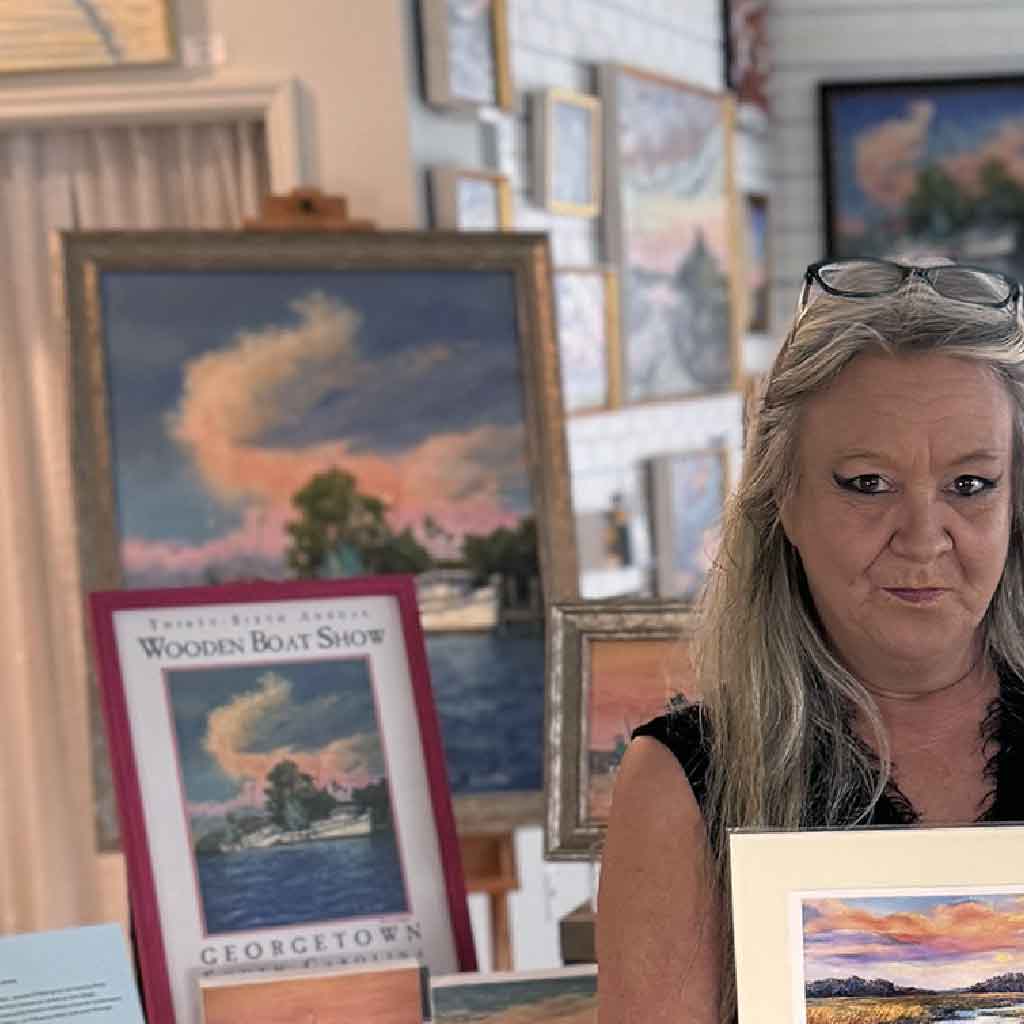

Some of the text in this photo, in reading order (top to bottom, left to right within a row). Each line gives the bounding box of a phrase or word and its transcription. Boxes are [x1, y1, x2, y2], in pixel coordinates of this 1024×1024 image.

[138, 626, 386, 660] WOODEN BOAT SHOW
[201, 922, 423, 965] GEORGETOWN
